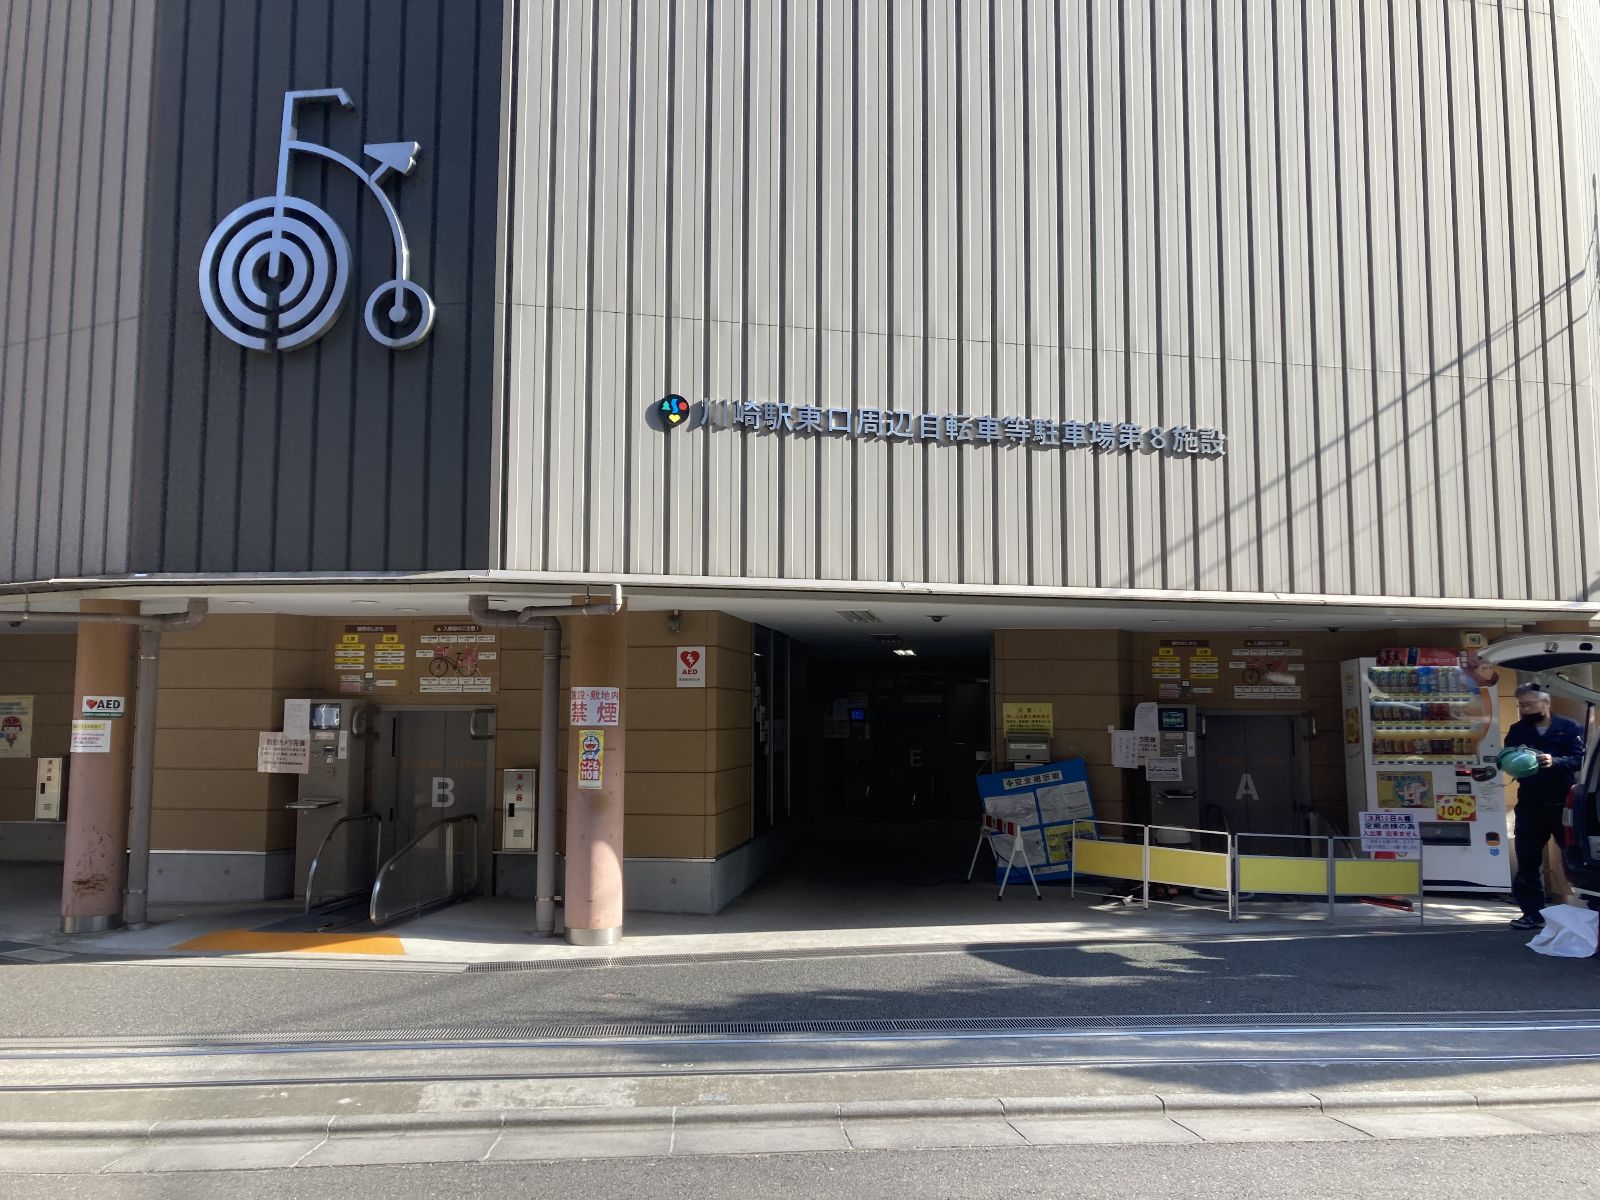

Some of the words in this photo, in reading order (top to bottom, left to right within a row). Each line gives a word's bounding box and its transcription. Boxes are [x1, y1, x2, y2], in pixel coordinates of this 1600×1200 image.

[97, 699, 121, 709] AED
[909, 749, 923, 767] E
[581, 760, 600, 771] こども
[580, 770, 600, 780] 110番
[431, 777, 455, 808] B
[1235, 773, 1260, 800] A
